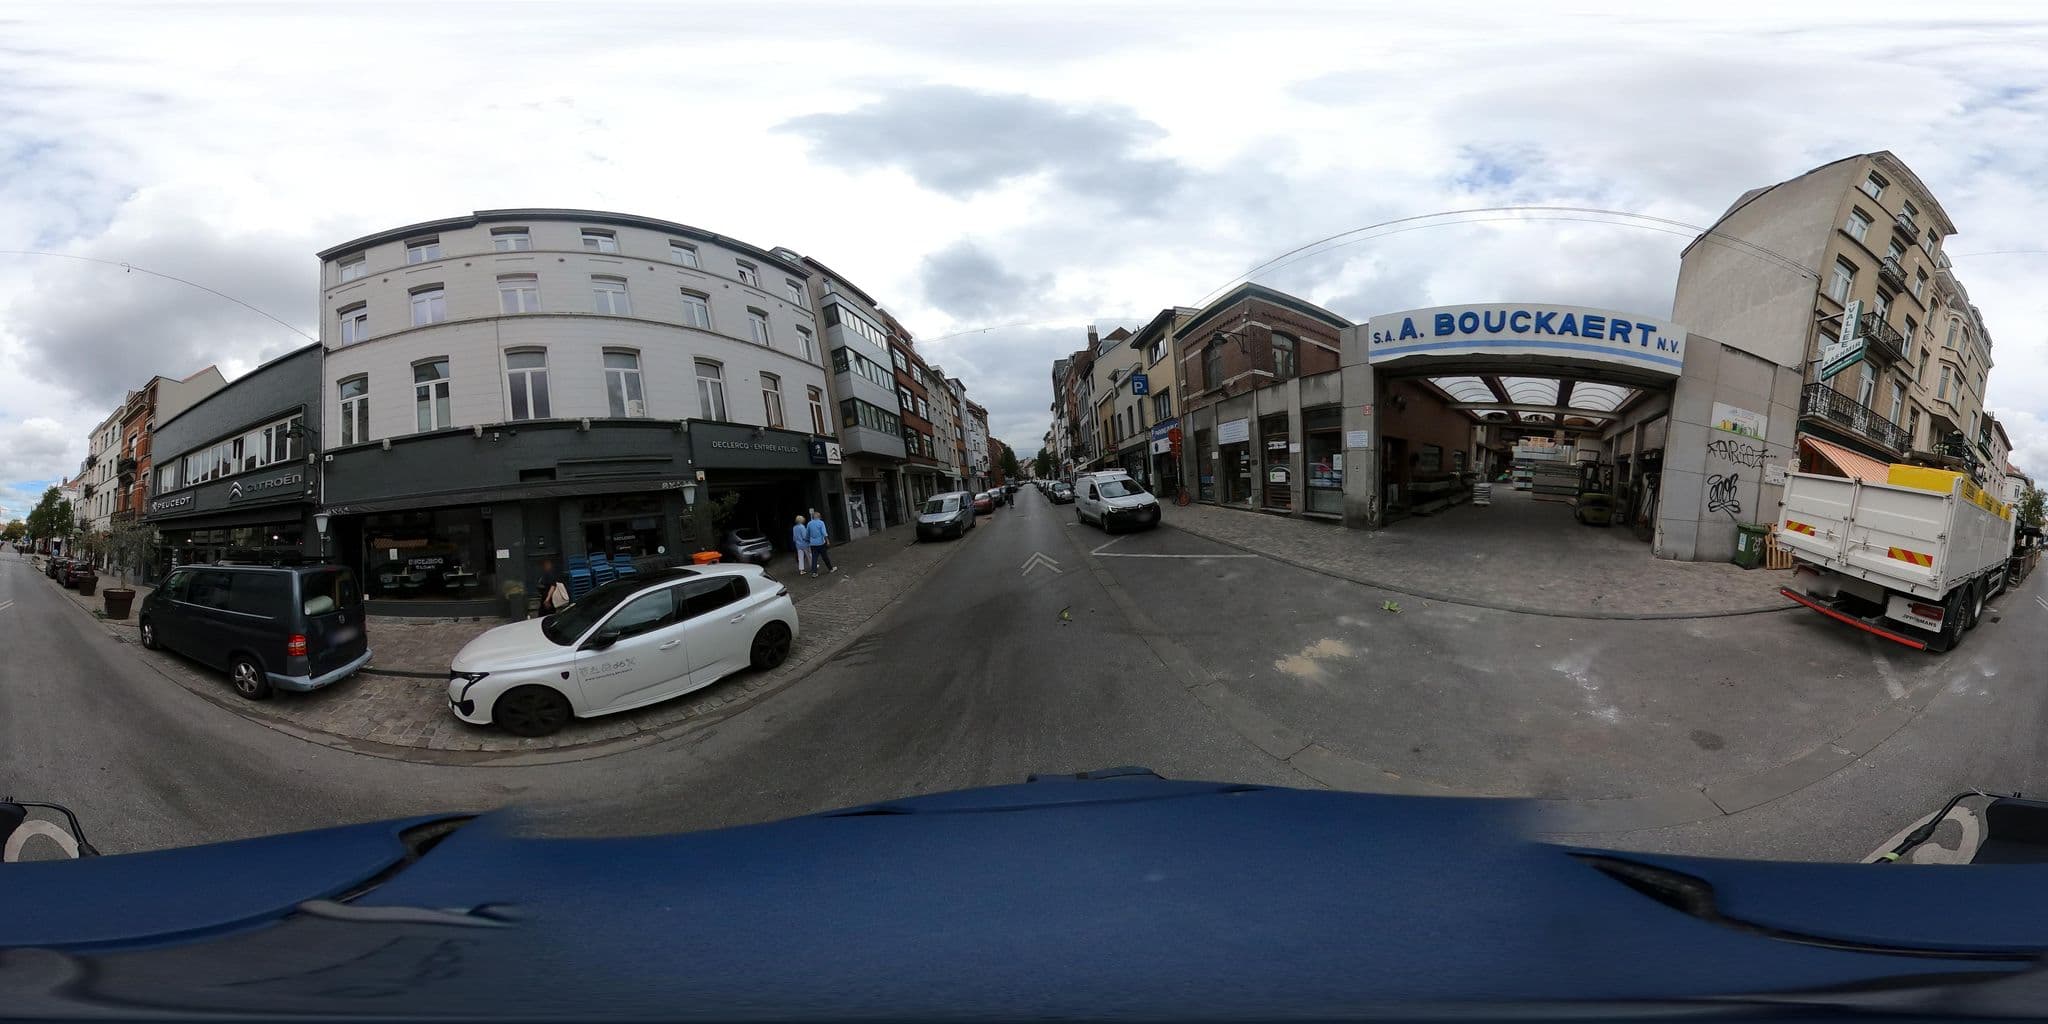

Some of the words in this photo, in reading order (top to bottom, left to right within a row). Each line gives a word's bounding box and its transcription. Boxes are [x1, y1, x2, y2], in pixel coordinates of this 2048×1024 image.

[1373, 329, 1396, 344] S.A.
[1399, 317, 1425, 341] A.
[1434, 310, 1657, 347] BOUCKAERT
[1657, 335, 1680, 354] N.V.
[1133, 381, 1144, 393] P
[712, 440, 750, 450] DECLERCQ
[157, 496, 192, 510] PEUGEOT
